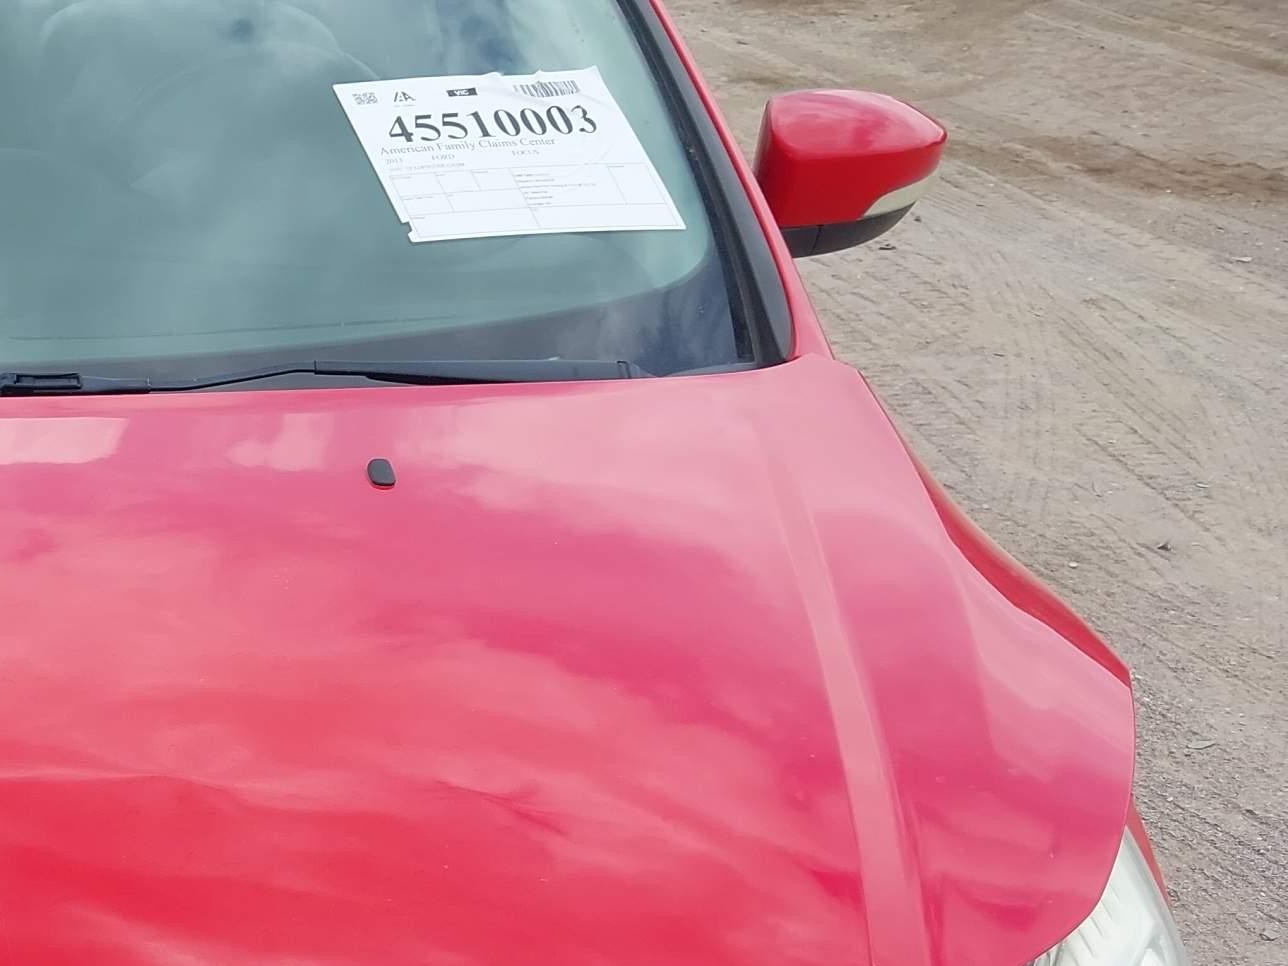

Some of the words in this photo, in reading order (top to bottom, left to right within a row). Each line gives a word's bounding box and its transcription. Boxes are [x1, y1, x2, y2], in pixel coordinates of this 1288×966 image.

[388, 105, 598, 143] 45510003
[381, 143, 434, 156] American
[436, 139, 475, 152] Family
[479, 136, 518, 148] Claims
[519, 136, 556, 146] Center
